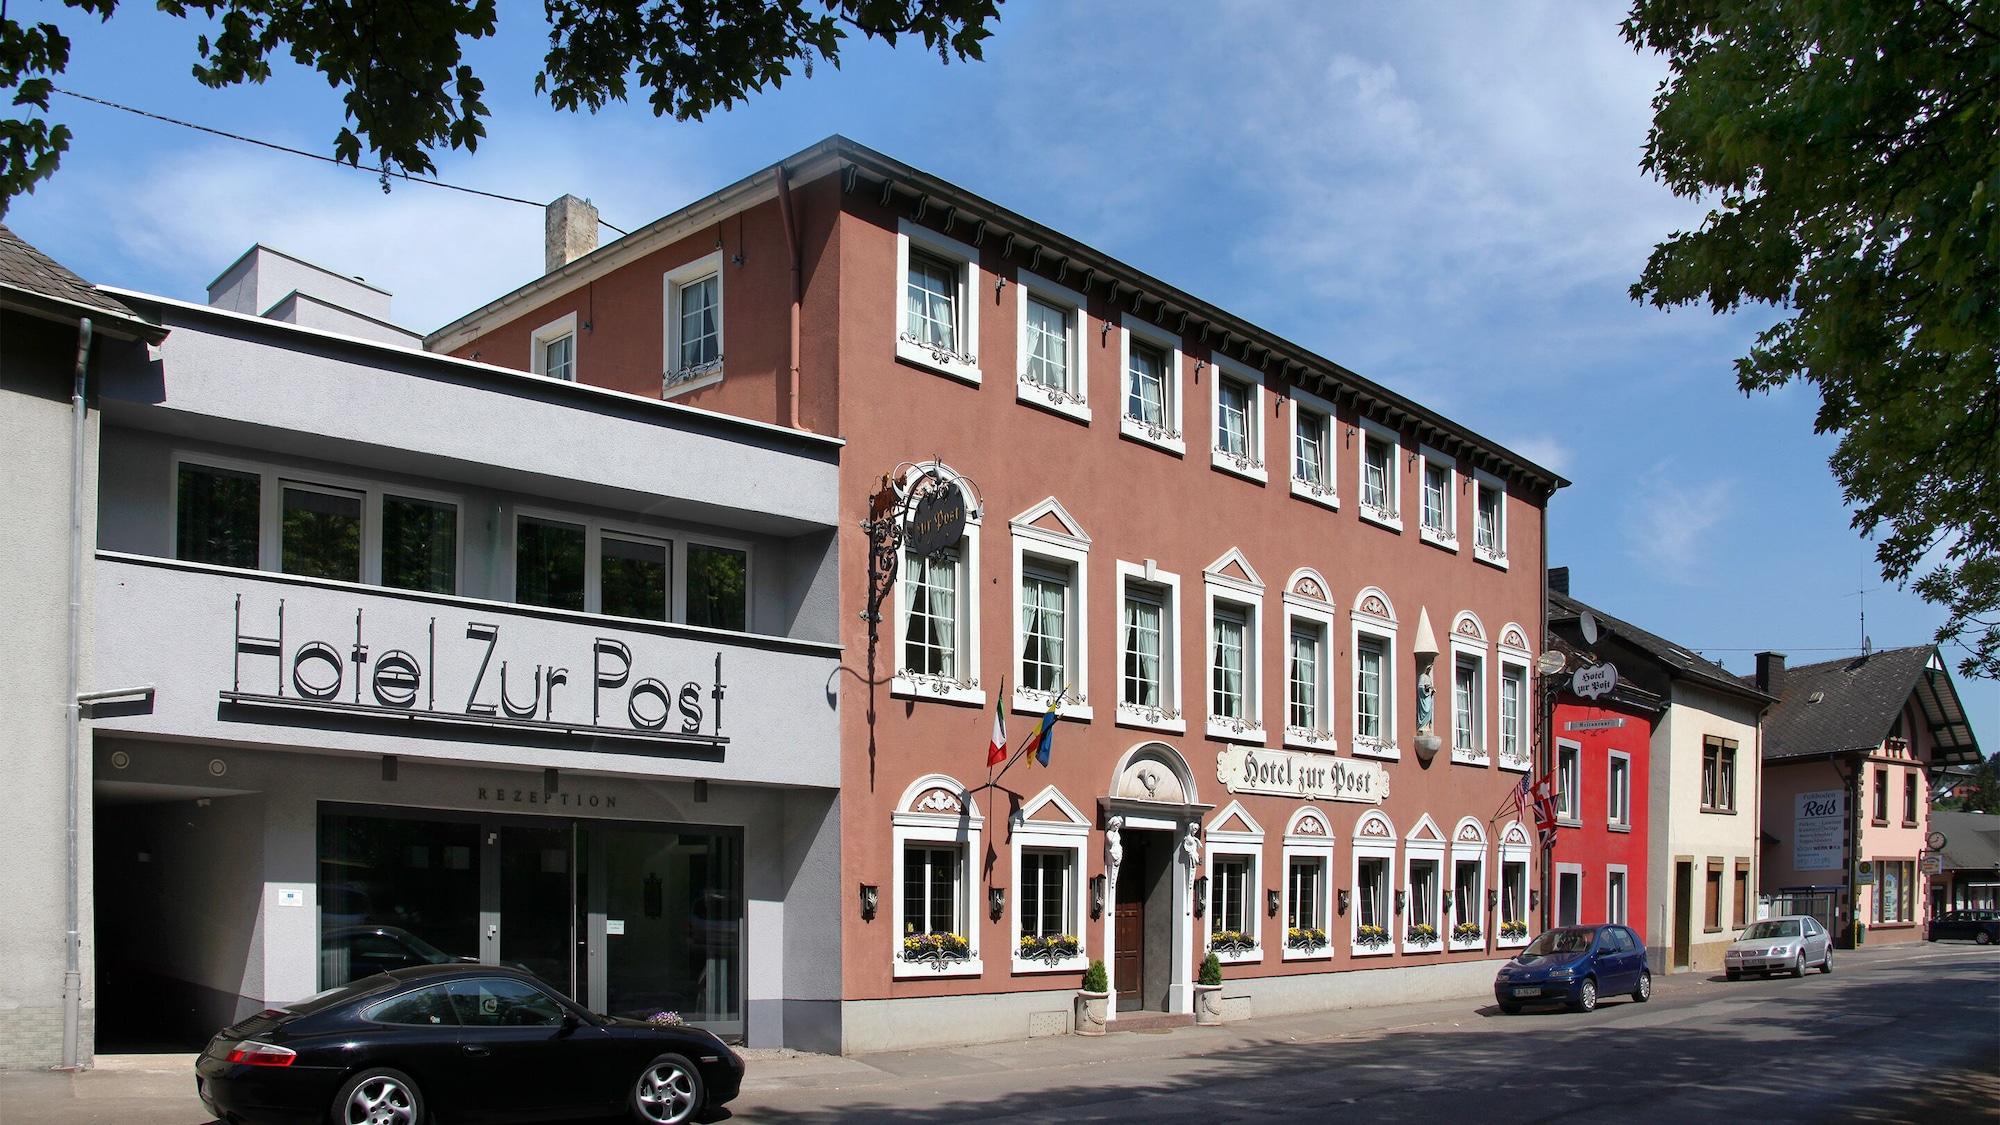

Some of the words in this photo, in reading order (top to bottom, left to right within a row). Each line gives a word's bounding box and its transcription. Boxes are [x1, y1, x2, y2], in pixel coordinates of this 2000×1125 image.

[934, 507, 960, 531] Post
[233, 593, 436, 711] Hotel
[466, 621, 568, 721] Zur
[594, 636, 728, 736] Post
[1582, 671, 1604, 682] Hotel
[1577, 684, 1590, 693] zur
[1243, 750, 1293, 788] Hotel
[1298, 765, 1325, 793] zur
[1330, 761, 1372, 797] Post
[478, 787, 616, 808] REZEPTION
[1803, 799, 1837, 817] Reis
